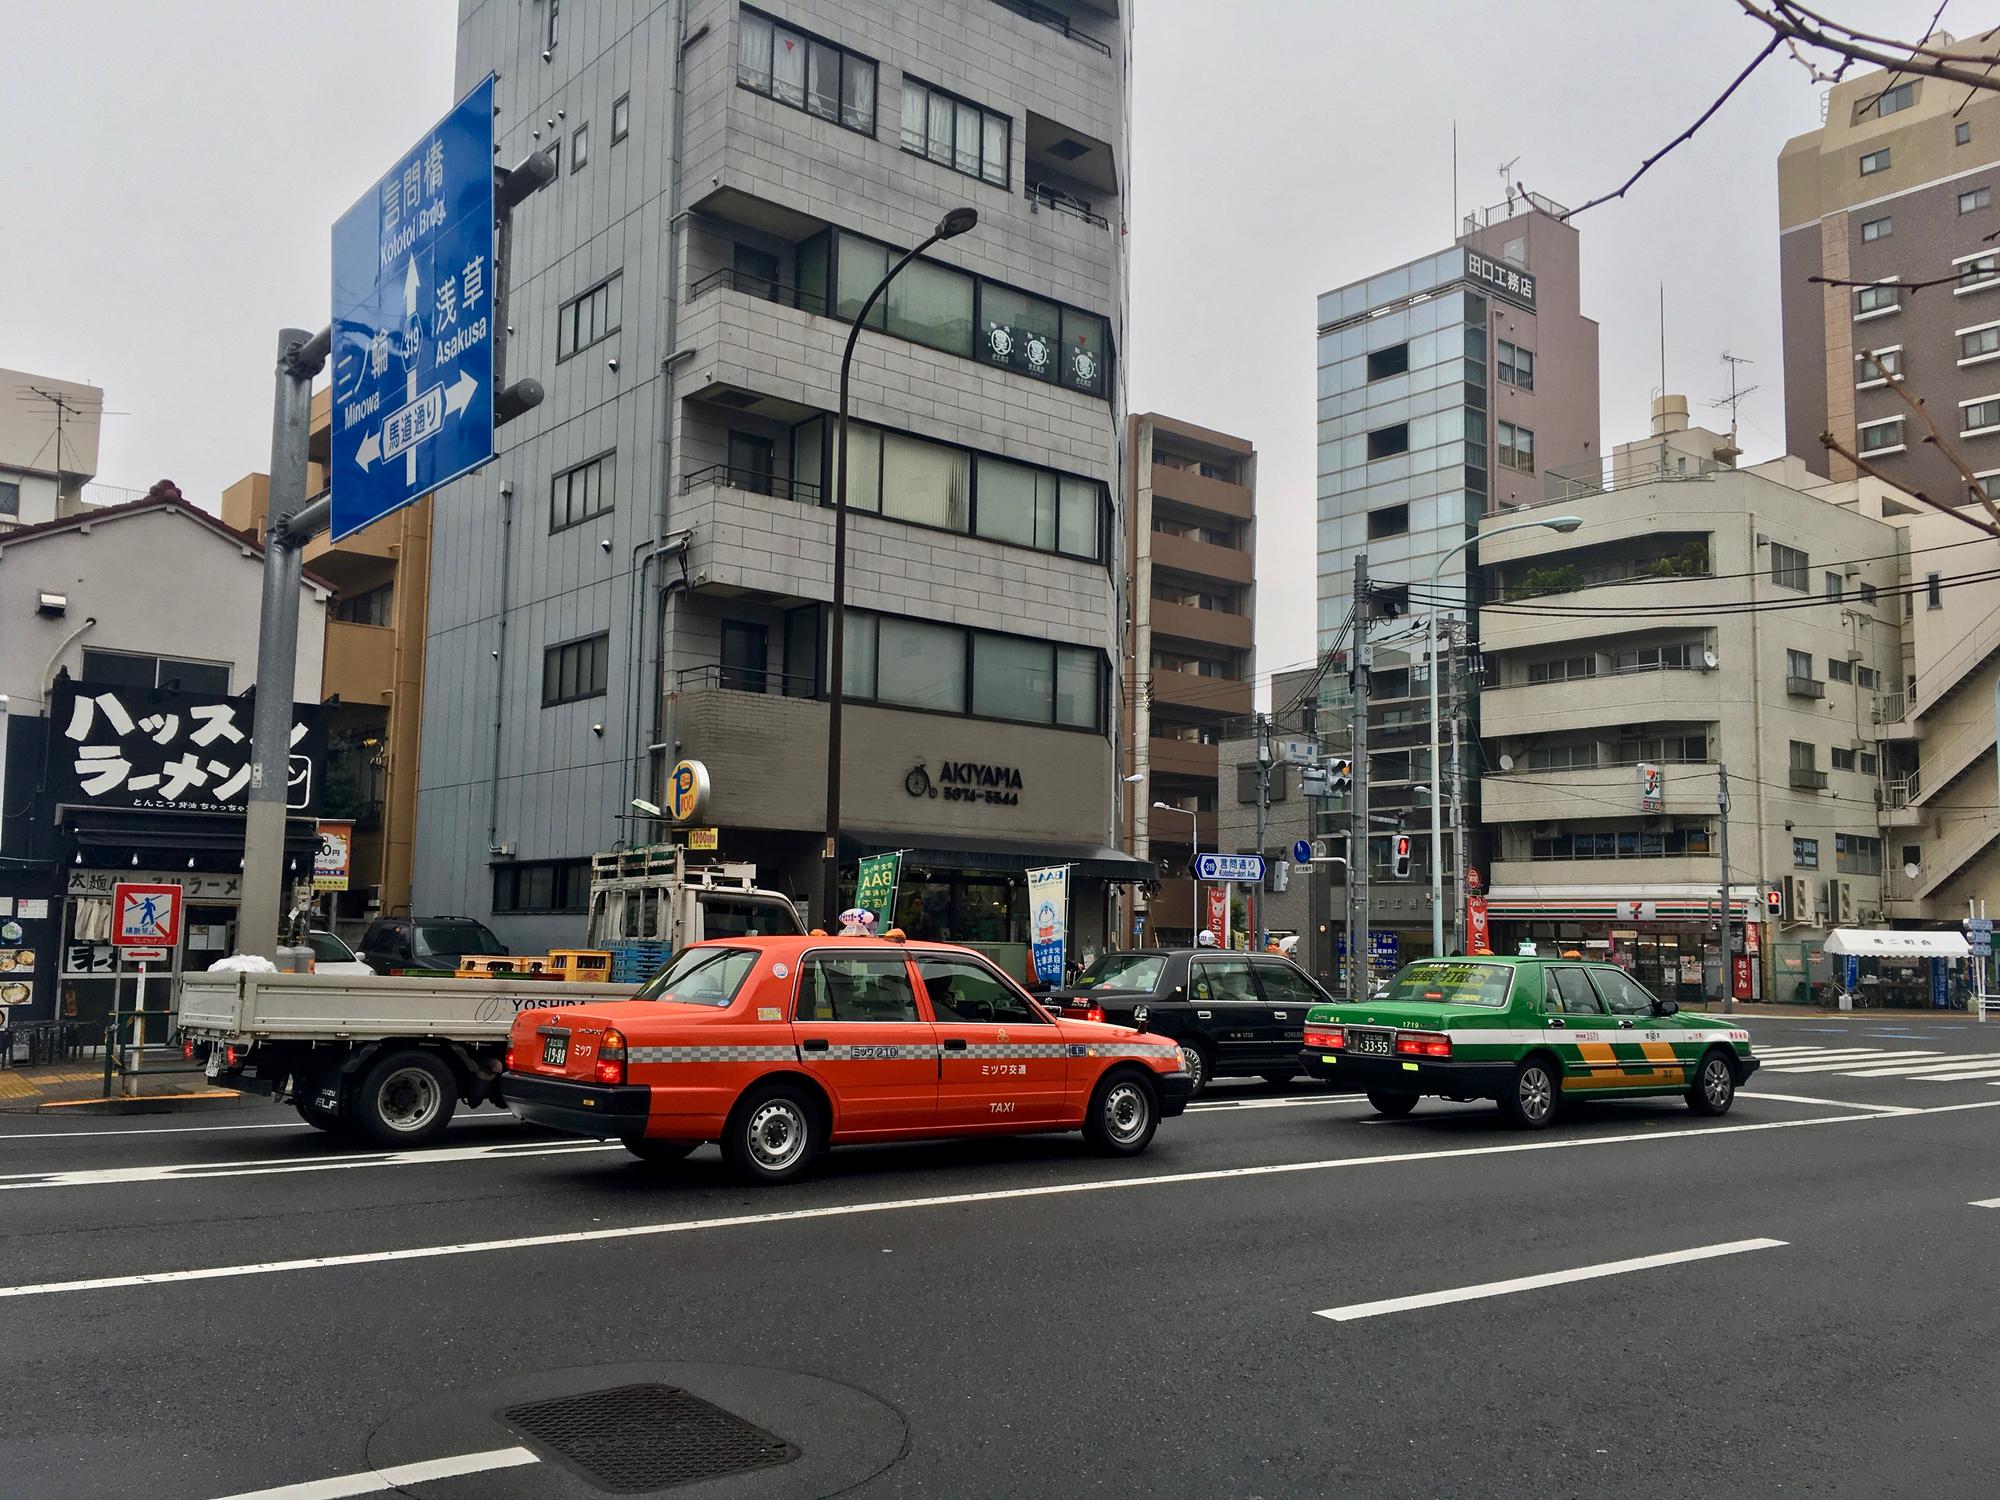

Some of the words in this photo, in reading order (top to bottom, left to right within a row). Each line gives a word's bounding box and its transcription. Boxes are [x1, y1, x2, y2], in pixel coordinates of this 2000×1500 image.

[384, 139, 444, 231] 言問橋
[381, 223, 417, 270] Kototoi
[418, 198, 447, 238] Brdg.
[1469, 253, 1532, 299] 田口工務店
[436, 255, 485, 336] 浅草
[404, 326, 419, 359] 319
[436, 316, 487, 369] Asakusa
[337, 328, 389, 404] 三ノ輪
[345, 391, 380, 431] Minowa
[388, 397, 437, 451] 馬道通り
[65, 692, 309, 748] ハッス
[74, 746, 251, 801] ラーメン
[940, 761, 1024, 790] AKIYAMA
[133, 798, 176, 808] とんこつ
[200, 802, 249, 813] ちゃっちゃ
[672, 767, 693, 817] P
[1205, 862, 1215, 872] 319
[1220, 858, 1256, 869] 言問通り
[126, 927, 156, 936] 横断禁止
[1738, 960, 1748, 989] おでん
[1402, 1021, 1419, 1029] 1719
[548, 1047, 566, 1065] 19-88
[574, 1044, 592, 1057] ミツワ
[876, 1046, 898, 1057] 210
[981, 1064, 1027, 1075] ミツワ交通
[989, 1101, 1015, 1113] TAXI
